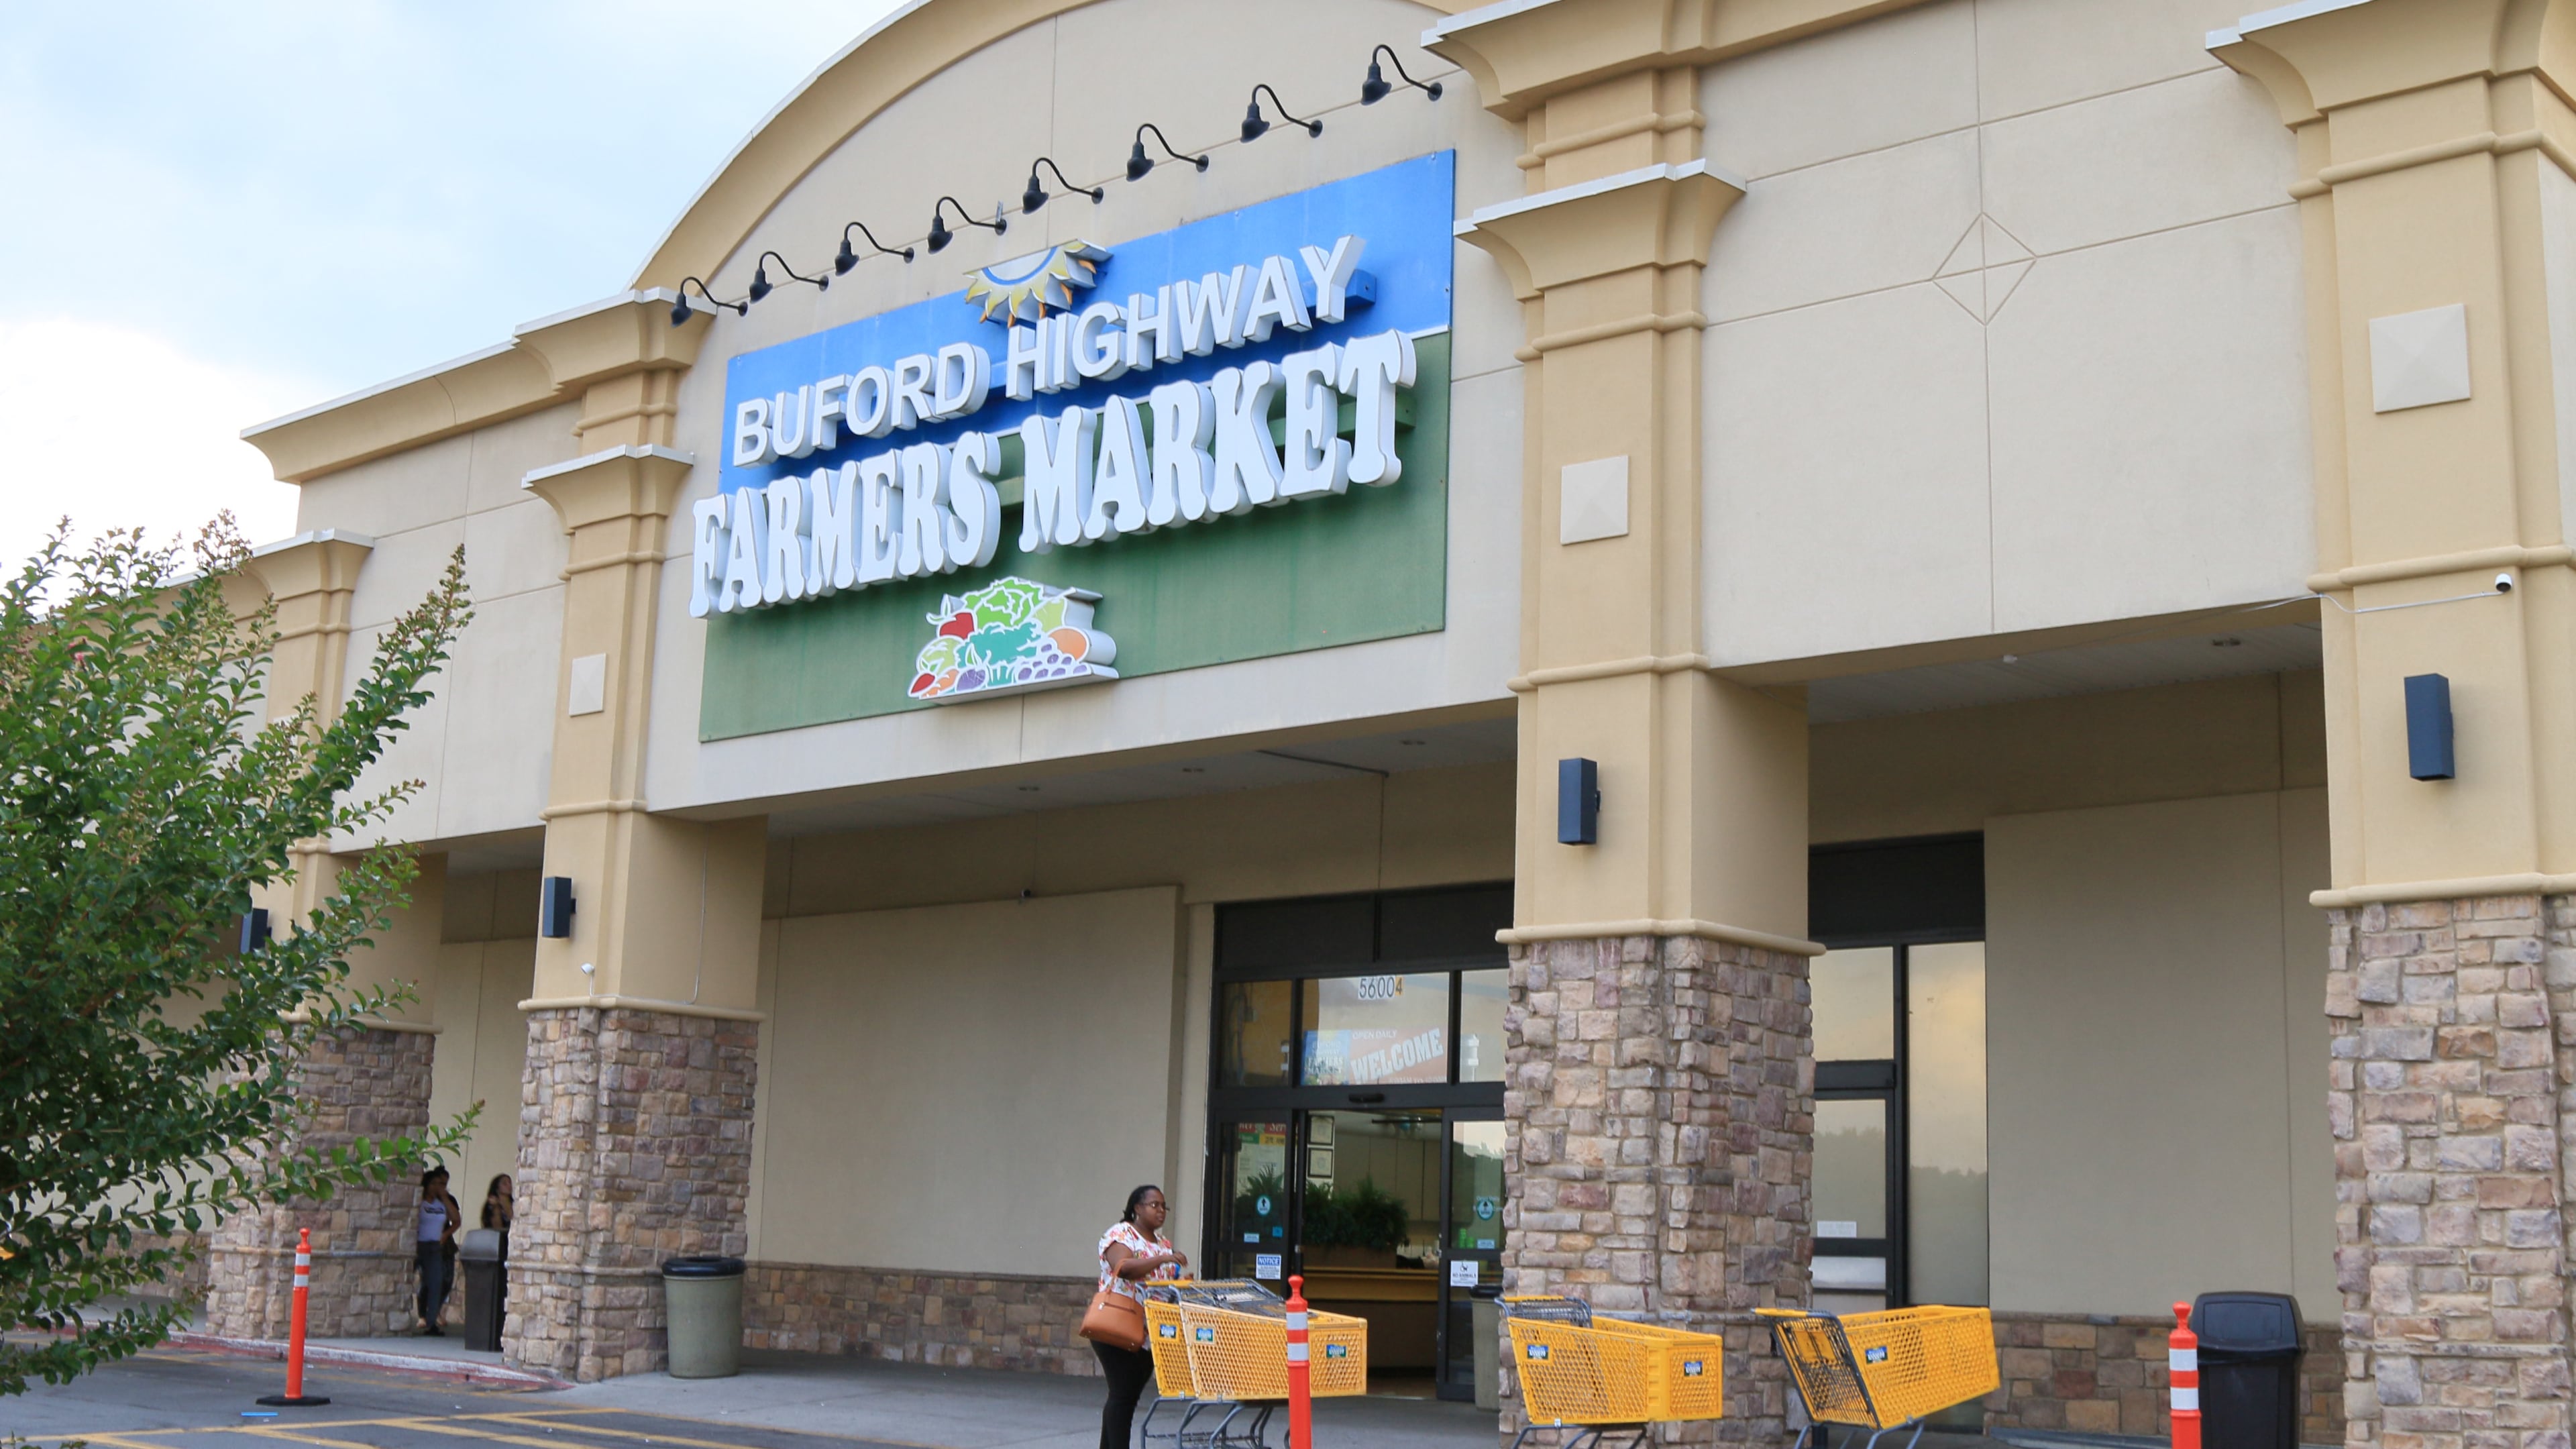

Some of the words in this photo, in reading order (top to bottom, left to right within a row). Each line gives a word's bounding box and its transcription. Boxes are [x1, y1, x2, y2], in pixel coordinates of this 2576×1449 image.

[733, 341, 991, 468] BUFORD
[1006, 233, 1366, 401] HIGHWAY
[689, 430, 1002, 619] FARMERS
[1018, 327, 1417, 555] MARKET
[1350, 1027, 1444, 1085] WELCOME
[1352, 1030, 1375, 1040] OPEN
[1375, 1030, 1397, 1038] DAILY
[1258, 1257, 1279, 1266] NOTICE
